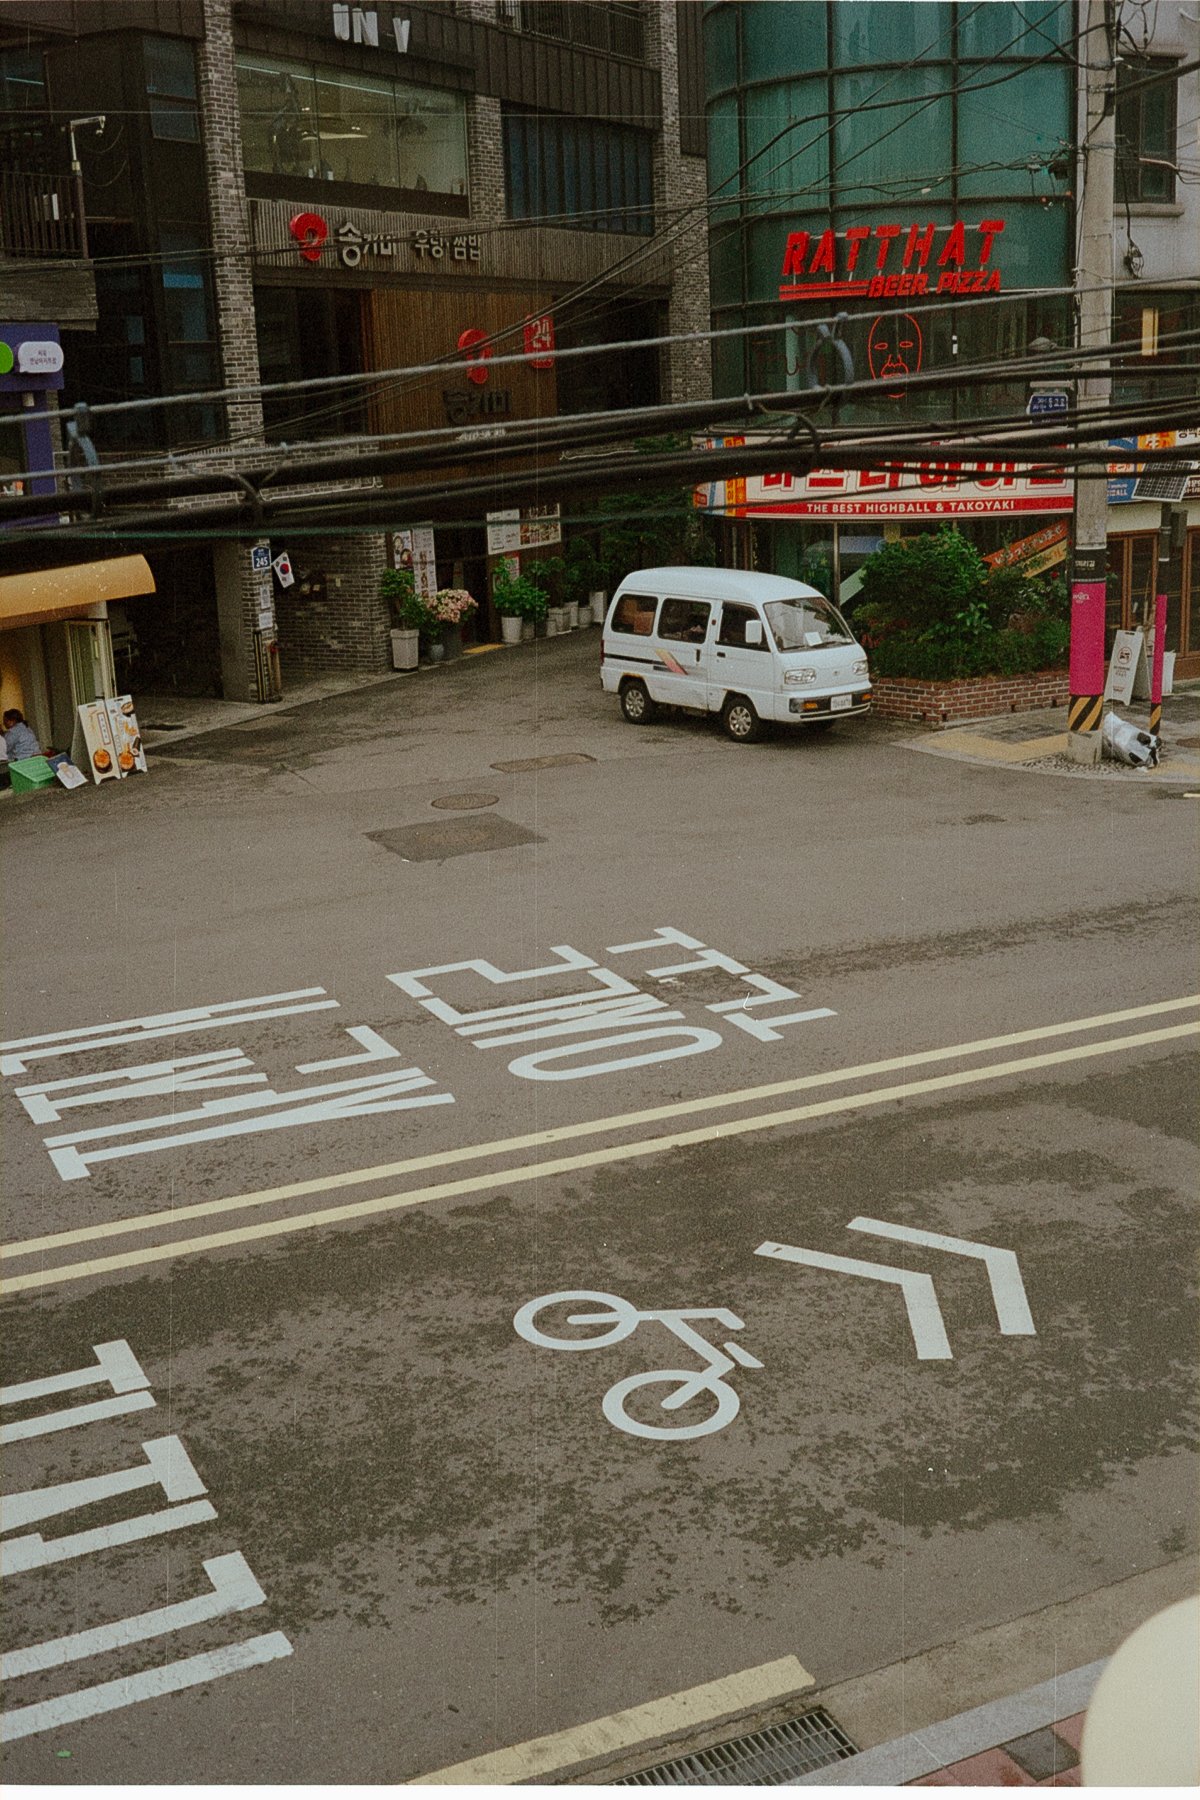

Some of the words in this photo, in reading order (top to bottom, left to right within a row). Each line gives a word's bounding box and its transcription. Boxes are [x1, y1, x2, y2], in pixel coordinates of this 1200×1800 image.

[781, 219, 1006, 277] RATTHAT
[936, 269, 1002, 294] PIZZA
[807, 503, 828, 514] THE
[832, 503, 862, 514] BEST
[865, 502, 931, 513] HIGHBALL
[935, 502, 945, 512] &
[949, 500, 1015, 512] TAKOYAKI
[255, 556, 269, 568] 245
[386, 926, 838, 1082] 우선도로
